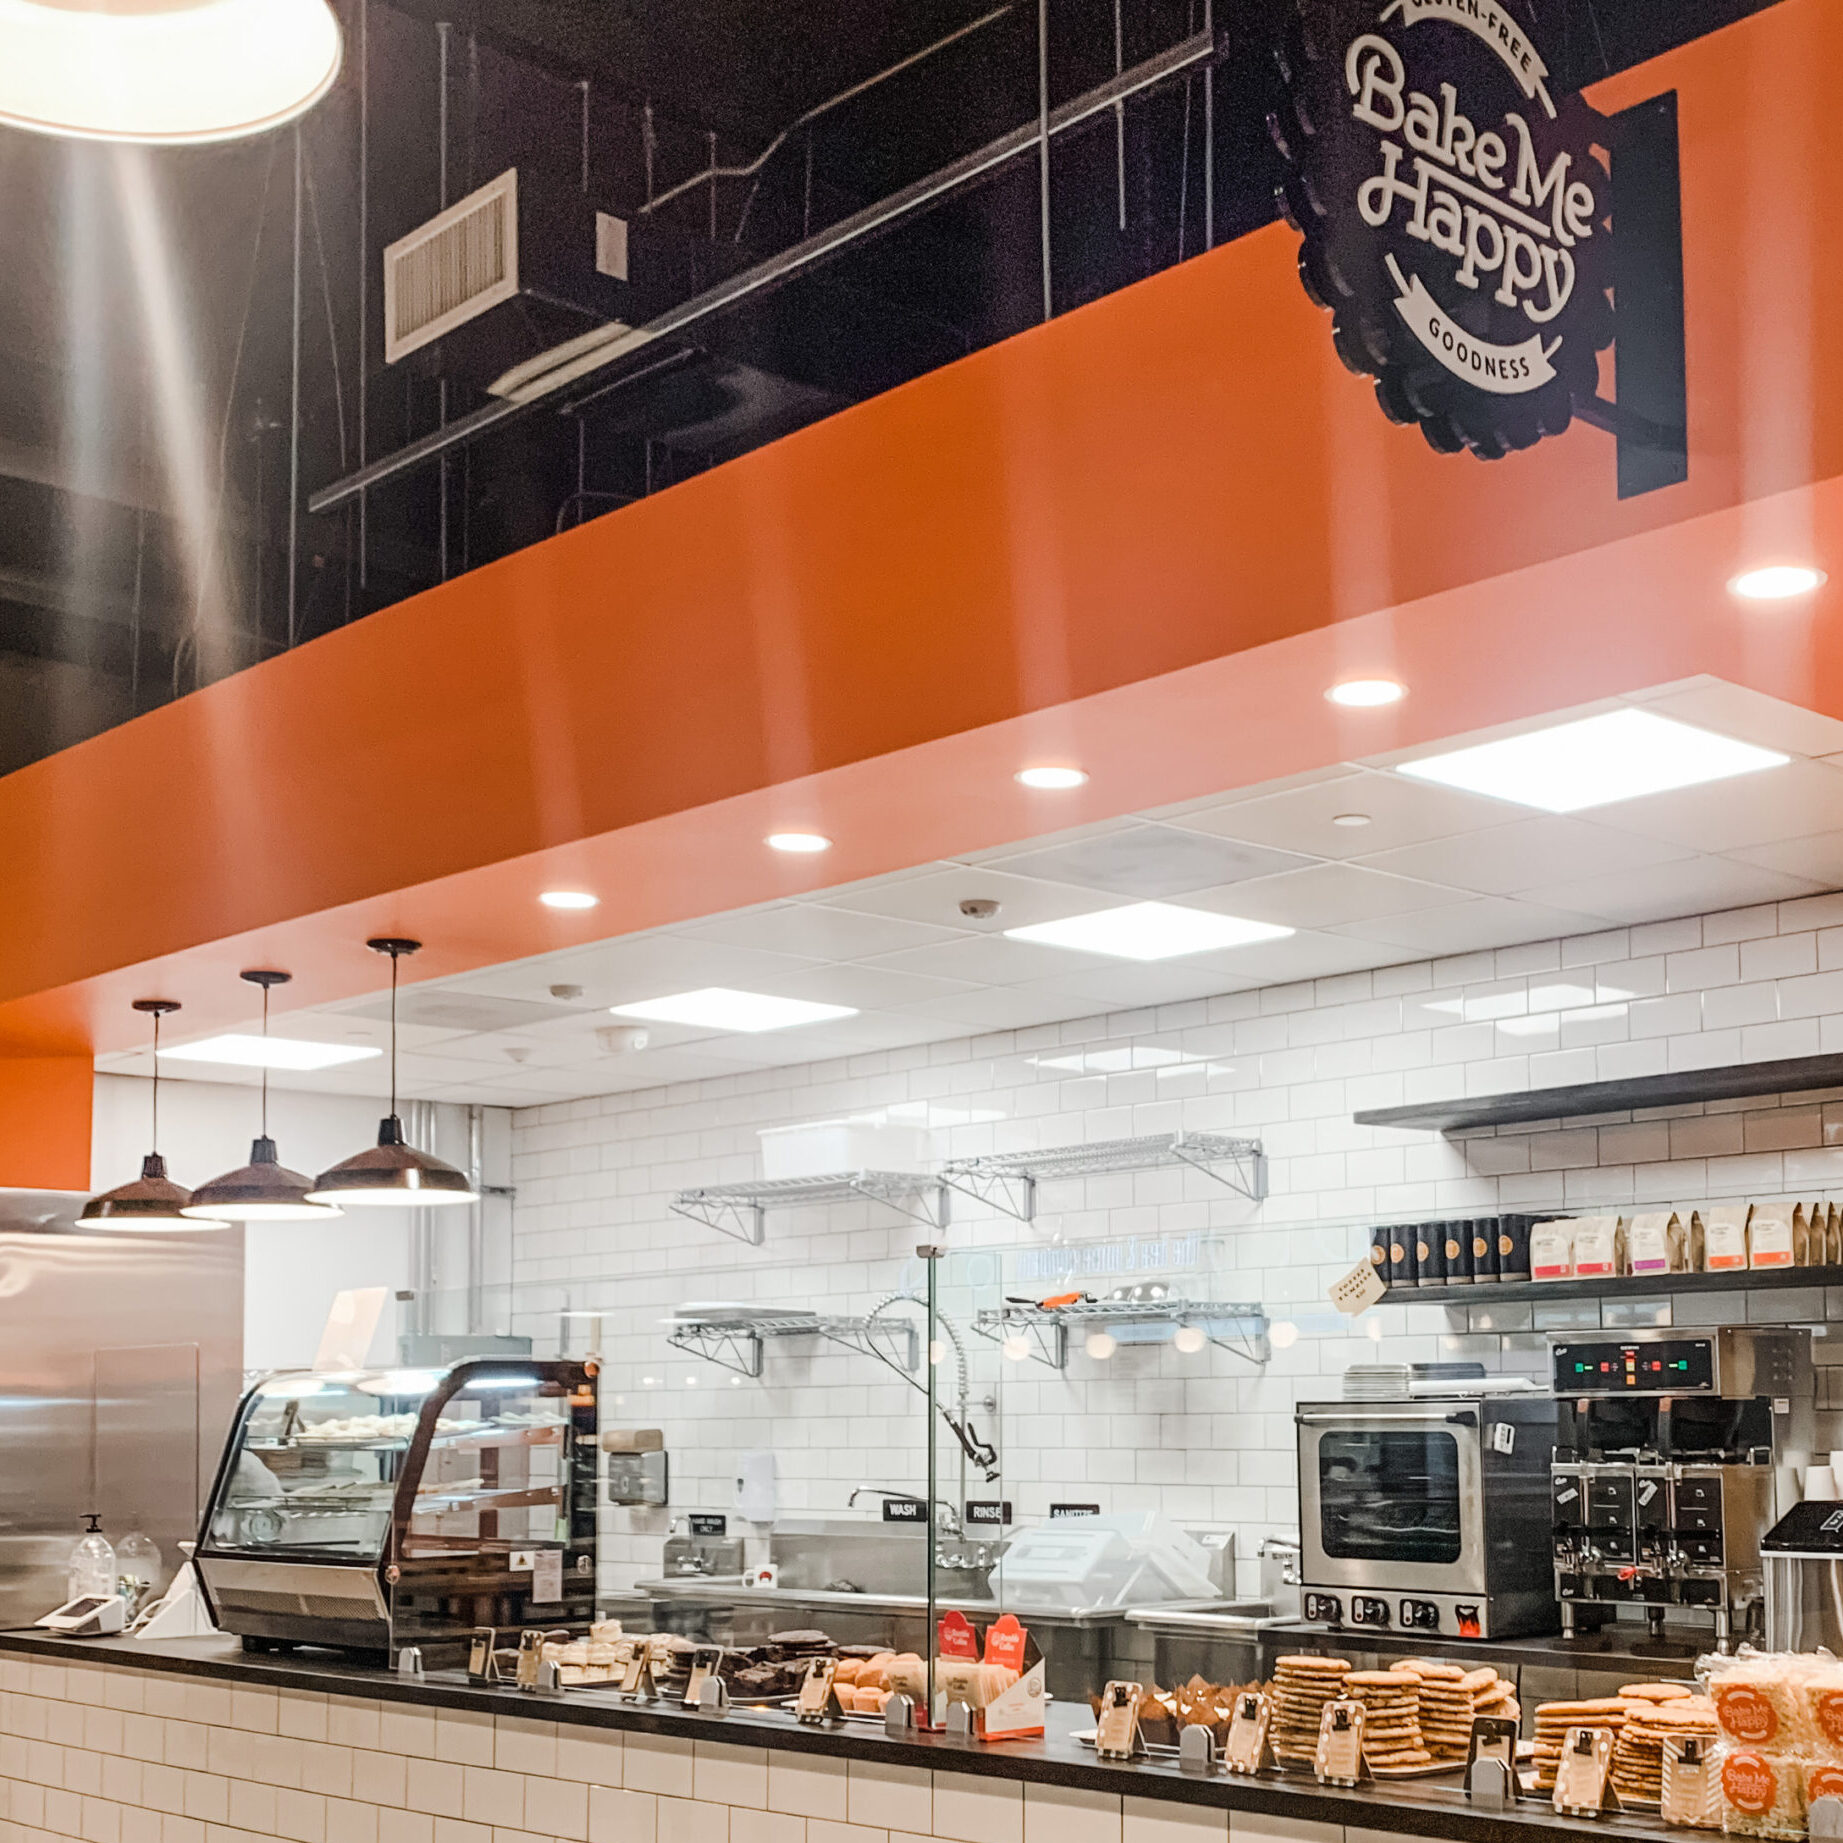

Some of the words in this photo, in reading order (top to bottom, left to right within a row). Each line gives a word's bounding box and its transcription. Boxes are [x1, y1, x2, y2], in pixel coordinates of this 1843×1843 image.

[1345, 34, 1507, 188] Bake
[1505, 113, 1594, 246] Me
[1357, 140, 1575, 323] Happy
[1428, 317, 1530, 379] GOODNESS
[889, 1503, 917, 1516] WASH
[973, 1506, 1001, 1519] RINSE
